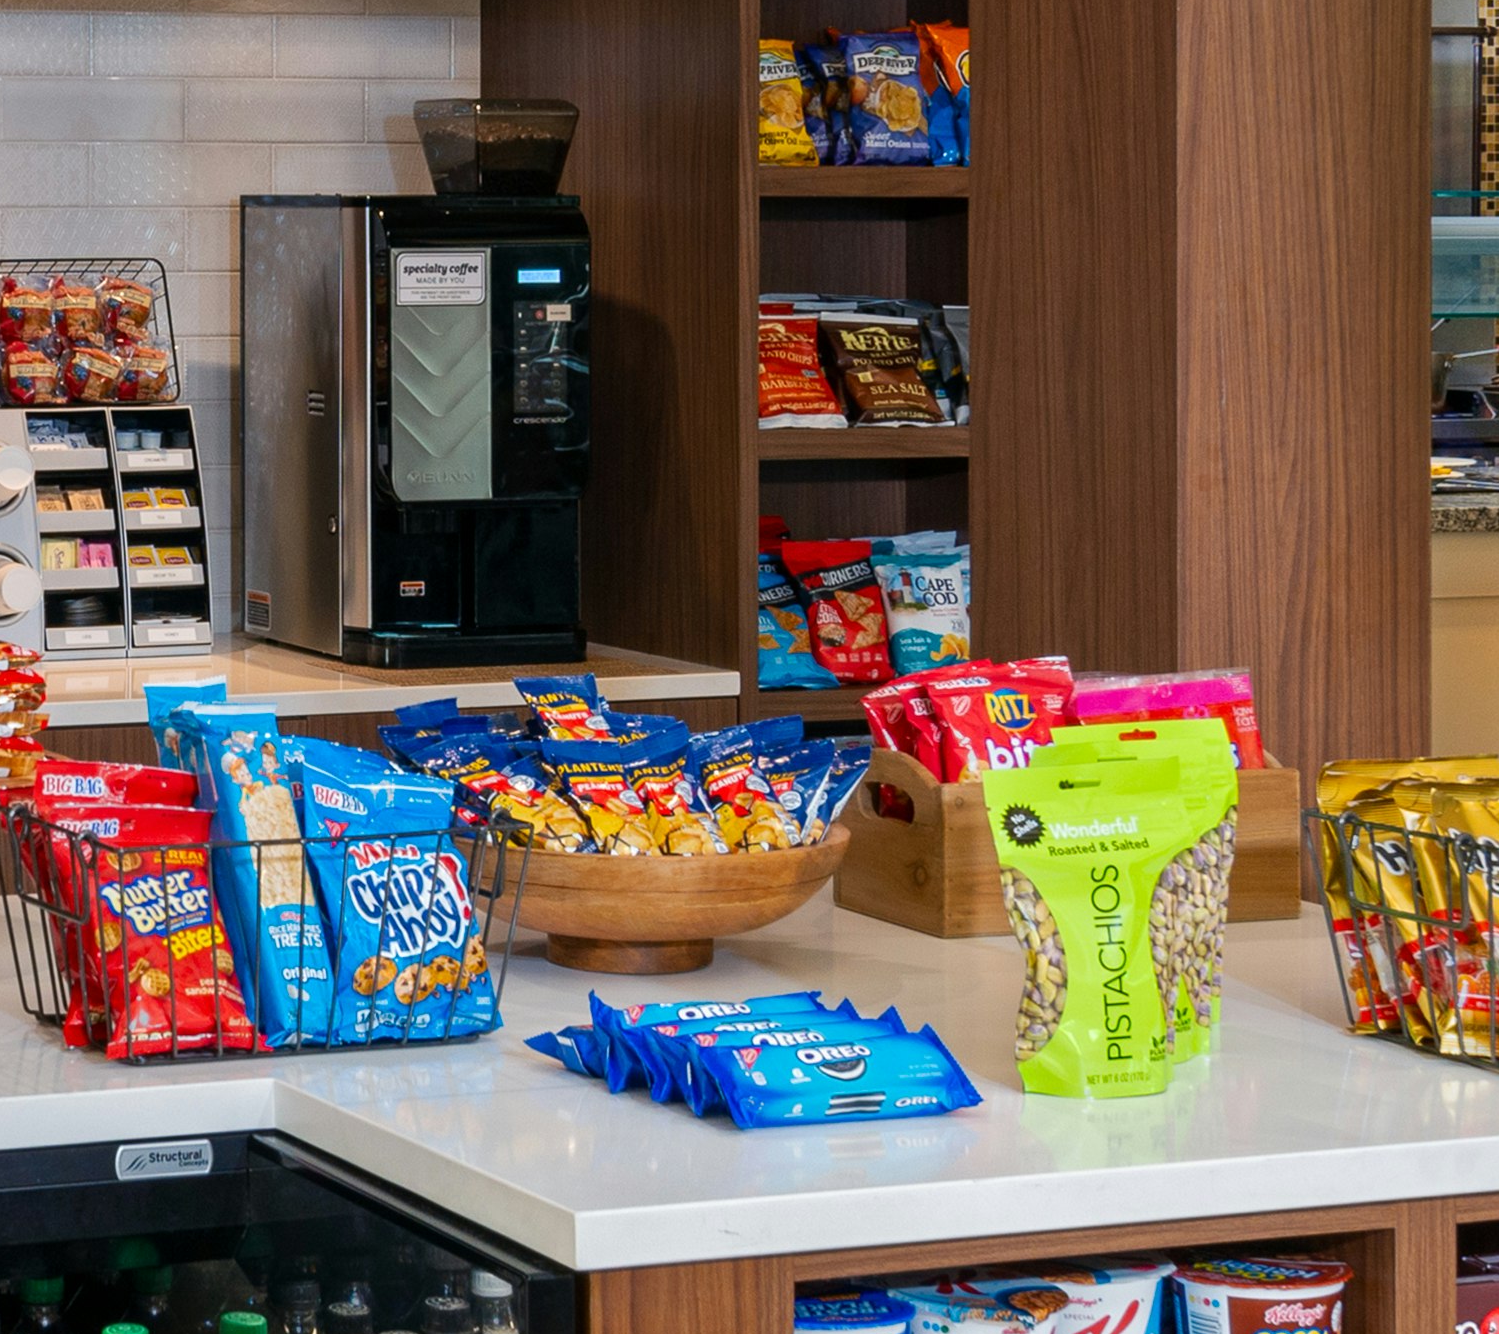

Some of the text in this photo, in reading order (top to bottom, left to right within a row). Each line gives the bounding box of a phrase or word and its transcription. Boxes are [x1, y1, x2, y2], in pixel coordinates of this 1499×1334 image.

[403, 263, 478, 275] specialty coffee
[870, 384, 927, 396] SEA SALT
[915, 576, 955, 592] CAPE
[923, 590, 958, 607] COD
[984, 691, 1037, 726] RITZ
[559, 762, 624, 775] PLANTERS
[43, 777, 102, 795] BIG BAG
[91, 820, 119, 837] BAG
[1012, 819, 1037, 837] Shells
[1049, 816, 1139, 839] Wonderful
[1048, 838, 1149, 857] Roasted & Salted
[102, 871, 193, 911] Nutter
[127, 887, 209, 934] Butter
[163, 924, 224, 960] Bites
[273, 931, 323, 949] TREATS
[1090, 863, 1133, 1061] PISTACHIOS
[678, 1002, 751, 1021] OREO
[796, 1043, 871, 1064] OREO
[148, 1149, 202, 1163] Structural
[1264, 1304, 1326, 1326] Kellogg's
